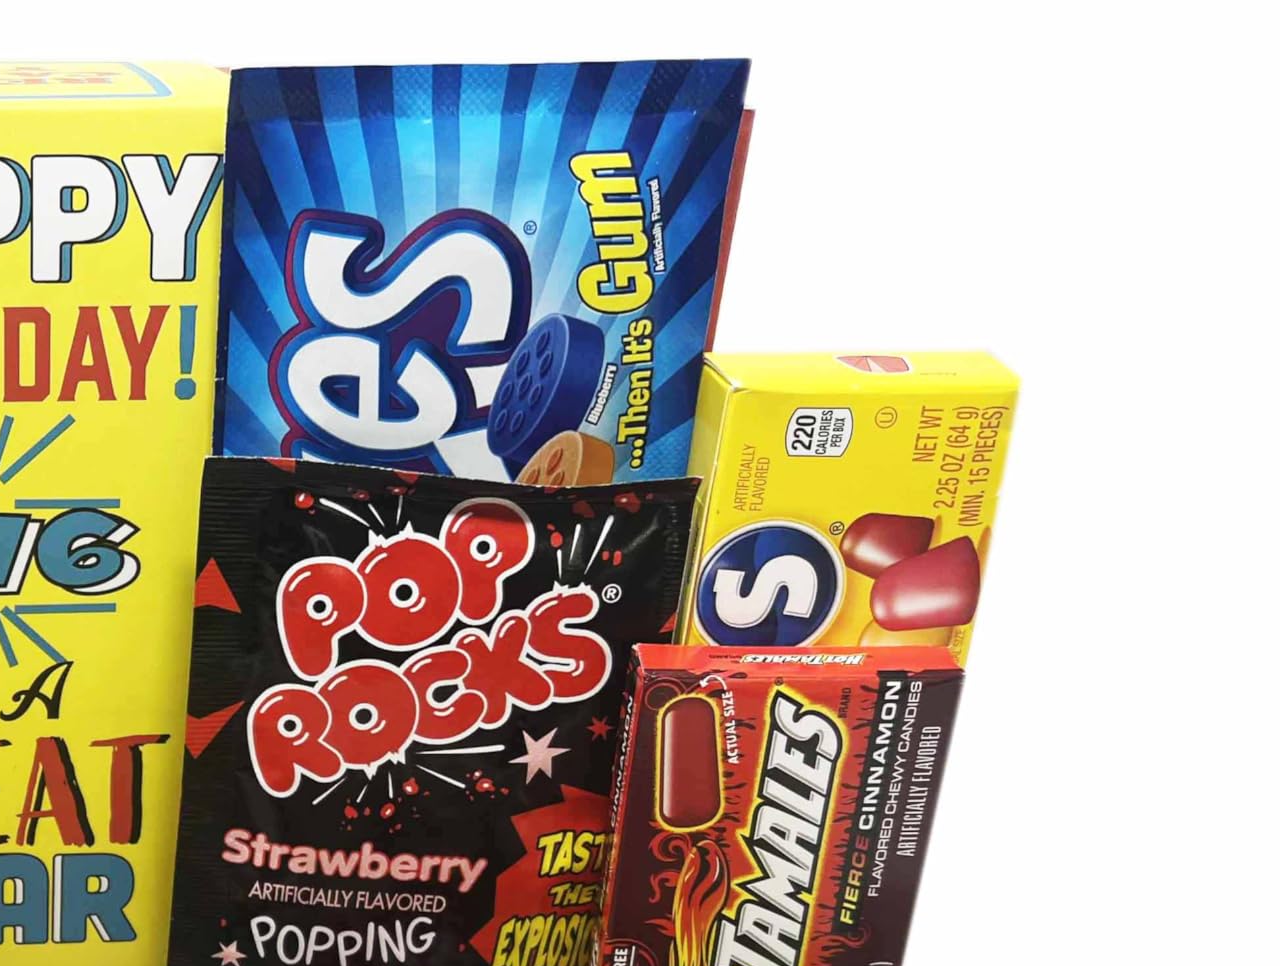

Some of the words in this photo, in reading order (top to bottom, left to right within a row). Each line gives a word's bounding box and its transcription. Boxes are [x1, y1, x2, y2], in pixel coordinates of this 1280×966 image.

[569, 150, 654, 315] Gum
[586, 363, 617, 426] Blueberry
[952, 406, 981, 422] g)
[791, 413, 818, 452] 220
[815, 409, 834, 456] CALORIES
[833, 417, 847, 434] BOX
[921, 405, 945, 431] WT
[945, 425, 972, 449] (64
[971, 406, 1010, 464] PIECES)
[830, 433, 845, 449] PER
[912, 431, 940, 463] NET
[733, 443, 758, 512] ARTIFICIALLY
[749, 456, 771, 512] FLAVORED
[940, 453, 967, 474] OZ
[967, 467, 991, 486] 15
[932, 476, 960, 510] 2.25
[957, 490, 986, 528] (MIN.
[276, 498, 536, 682] POP
[0, 661, 74, 720] A
[246, 582, 614, 799] ROCKS
[722, 690, 736, 718] SIZE
[837, 686, 852, 719] BRAND
[724, 719, 740, 766] ACTUAL
[839, 834, 870, 925] FIERCE
[858, 680, 903, 831] CINNAMON
[868, 815, 894, 897] FLAVORED
[884, 754, 909, 815] CHEWY
[897, 680, 924, 754] CANDIES
[895, 785, 926, 857] ARTIFICIALLY
[914, 724, 943, 784] FLAVORED
[221, 827, 489, 893] Strawberry
[247, 880, 355, 909] ARTIFICIALLY
[355, 890, 447, 914] FLAVORED
